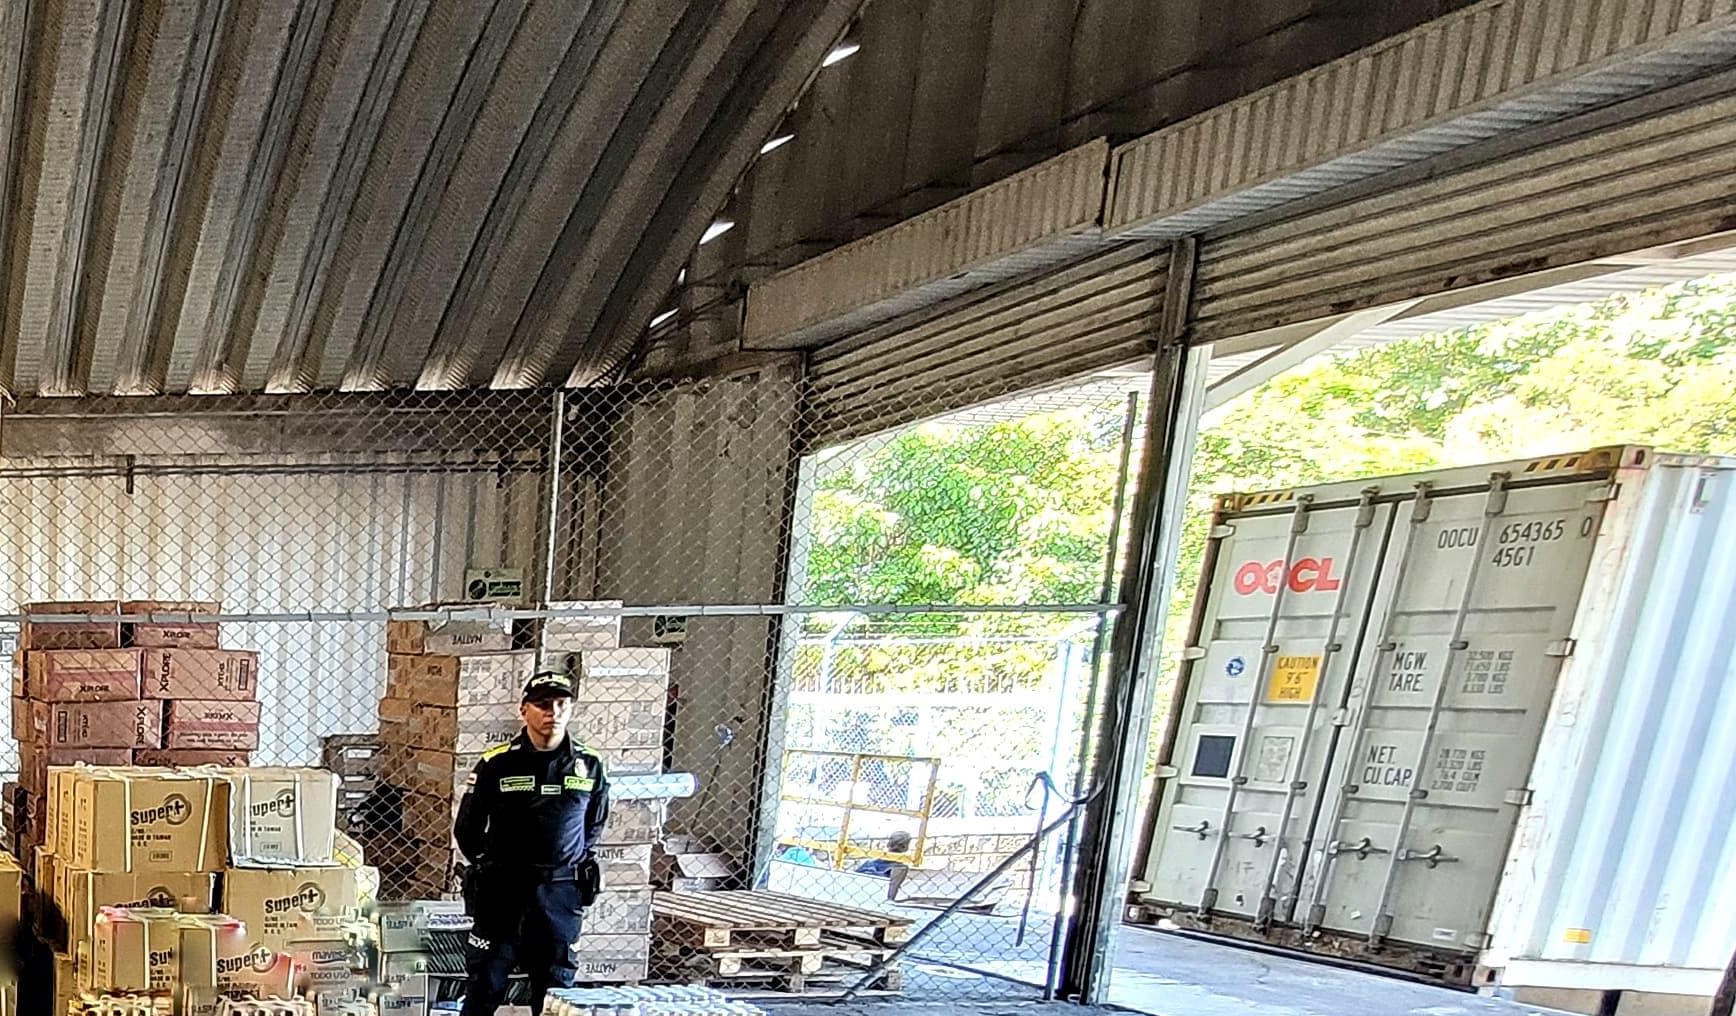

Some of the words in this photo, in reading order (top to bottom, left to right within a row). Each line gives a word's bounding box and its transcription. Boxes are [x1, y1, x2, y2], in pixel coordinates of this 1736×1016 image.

[1438, 527, 1478, 549] OOCU
[1499, 520, 1566, 545] 654365
[1580, 516, 1593, 539] 0
[1491, 546, 1534, 568] 45G1
[1234, 558, 1341, 596] OOCL
[451, 633, 483, 645] NATIVE
[159, 652, 172, 692] XPLORE
[1277, 656, 1321, 670] CAUTION
[1393, 651, 1427, 671] MGW.
[136, 705, 146, 746] XPLORE
[1367, 745, 1396, 764] NET.
[131, 795, 190, 826] Super+
[250, 793, 296, 817] uper+
[265, 889, 320, 914] Super+
[217, 948, 273, 974] Super+
[585, 963, 616, 974] NATIVE
